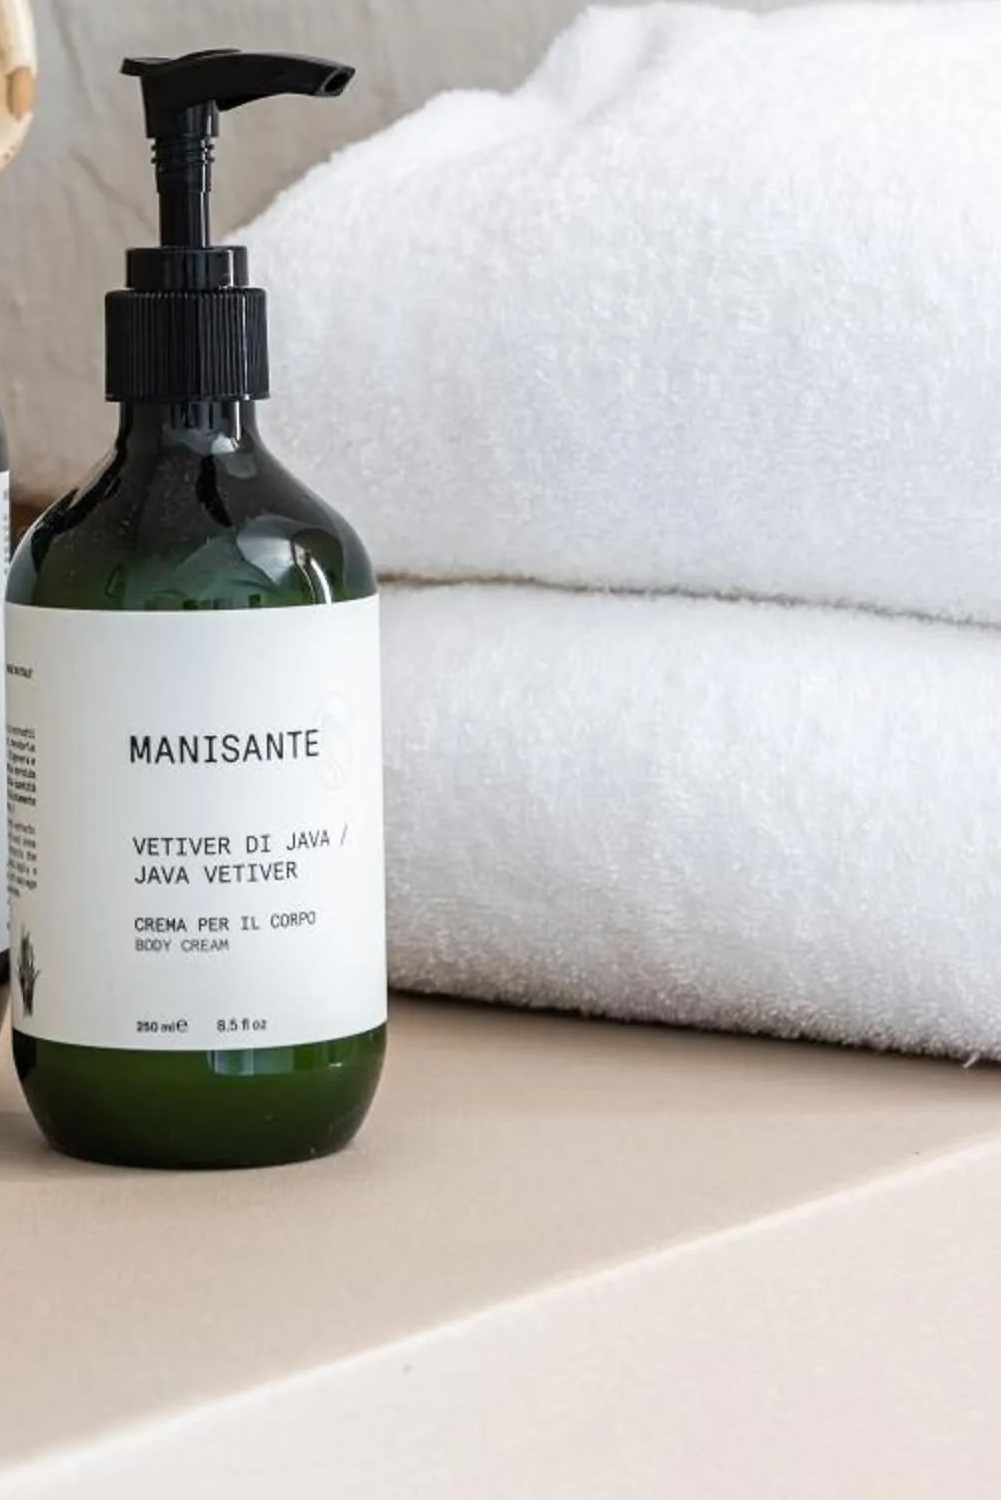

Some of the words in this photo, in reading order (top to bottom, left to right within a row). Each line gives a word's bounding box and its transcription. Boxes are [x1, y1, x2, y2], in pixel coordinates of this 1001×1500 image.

[129, 728, 320, 765] MANISANTE
[132, 836, 232, 857] VETIVER
[245, 833, 272, 855] DI
[285, 829, 330, 852] JAVA
[339, 822, 349, 847] /
[134, 865, 190, 885] JAVA
[202, 860, 299, 884] VETIVER
[134, 916, 188, 933] CREMA
[197, 916, 230, 933] PER
[240, 915, 261, 932] IL
[269, 910, 317, 930] CORPO
[134, 937, 173, 953] BODY
[180, 938, 230, 954] CREAM
[136, 1020, 160, 1034] 250
[216, 1017, 239, 1033] 8.5
[240, 1017, 250, 1031] fl
[252, 1019, 268, 1032] oz
